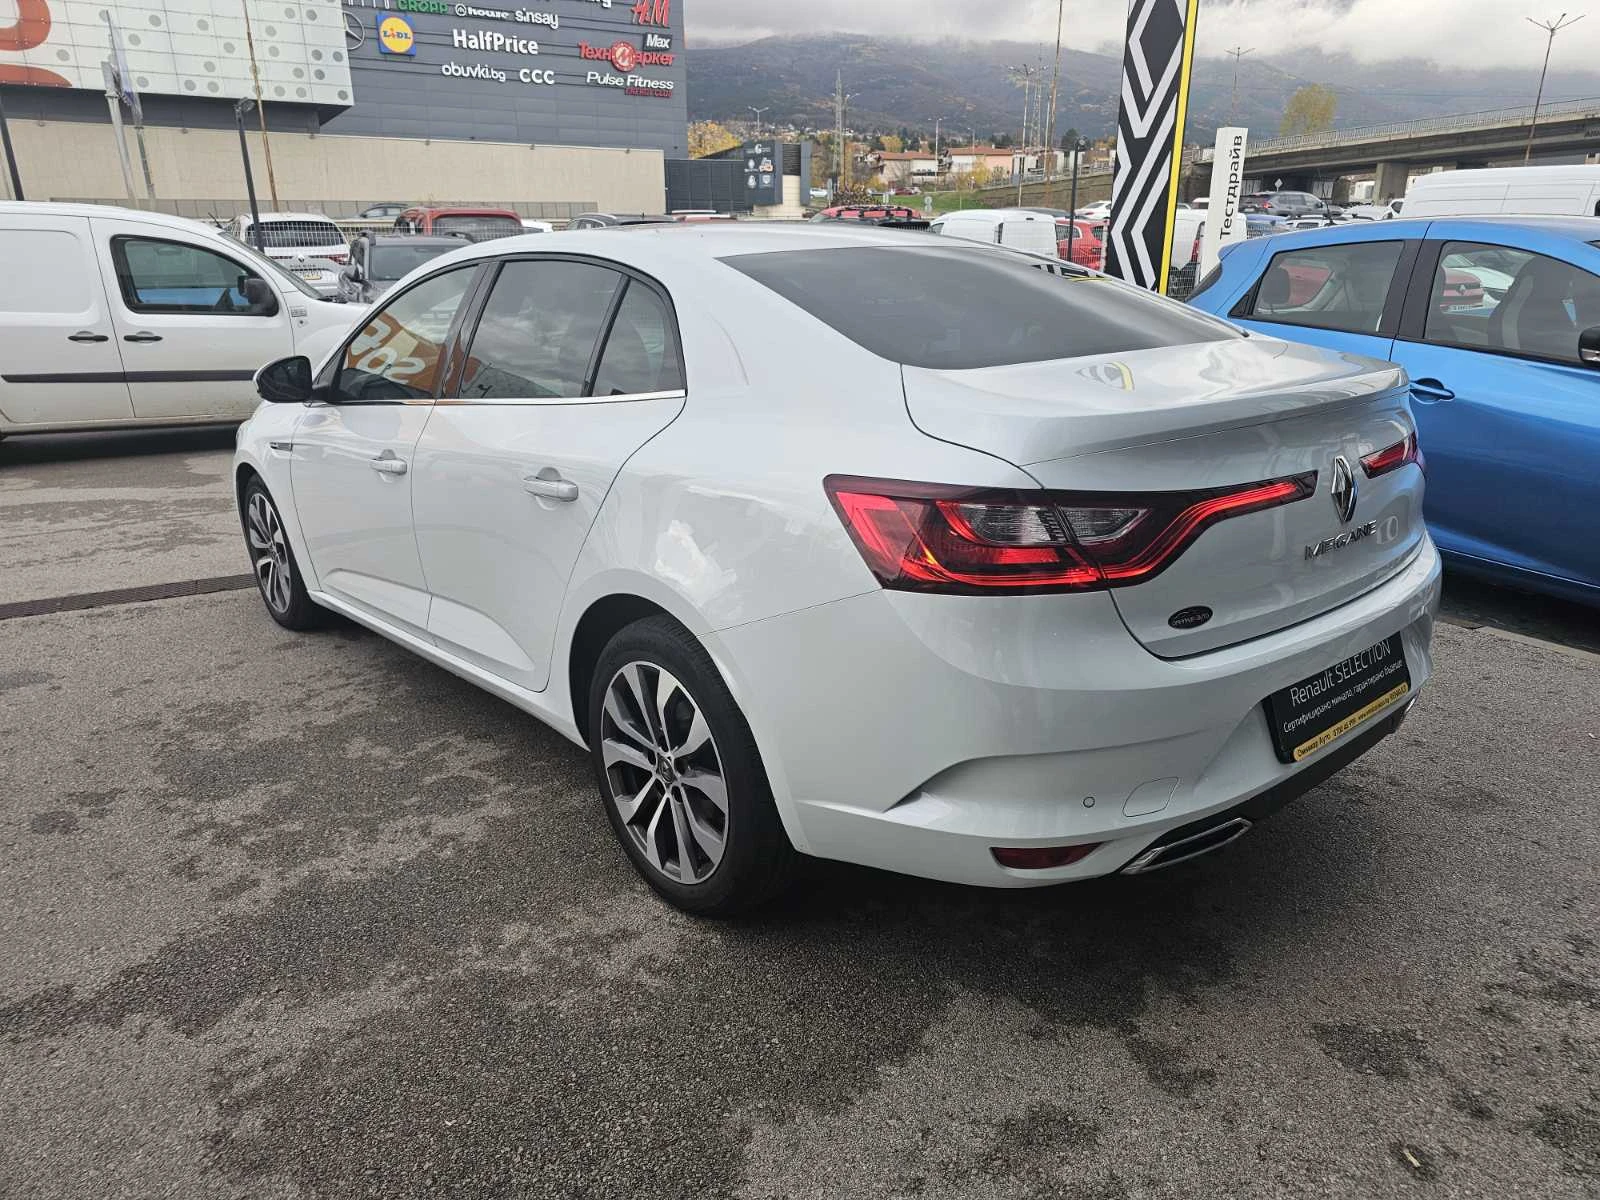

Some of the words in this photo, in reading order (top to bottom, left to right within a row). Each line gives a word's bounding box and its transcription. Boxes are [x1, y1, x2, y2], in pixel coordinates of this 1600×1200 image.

[515, 7, 559, 29] sinsay
[383, 27, 411, 40] LIDL
[453, 28, 539, 54] HalfPrice
[646, 33, 670, 48] Max
[441, 61, 506, 83] obuvki.bg
[519, 68, 555, 85] CCC
[586, 71, 625, 86] Pulse
[627, 74, 674, 90] Fitness
[1220, 135, 1242, 240] Тестдрайв
[1304, 519, 1377, 560] MEGANE
[1290, 670, 1335, 707] Renault
[1335, 639, 1391, 683] SELECTION
[1283, 701, 1331, 733] Сертифицирано
